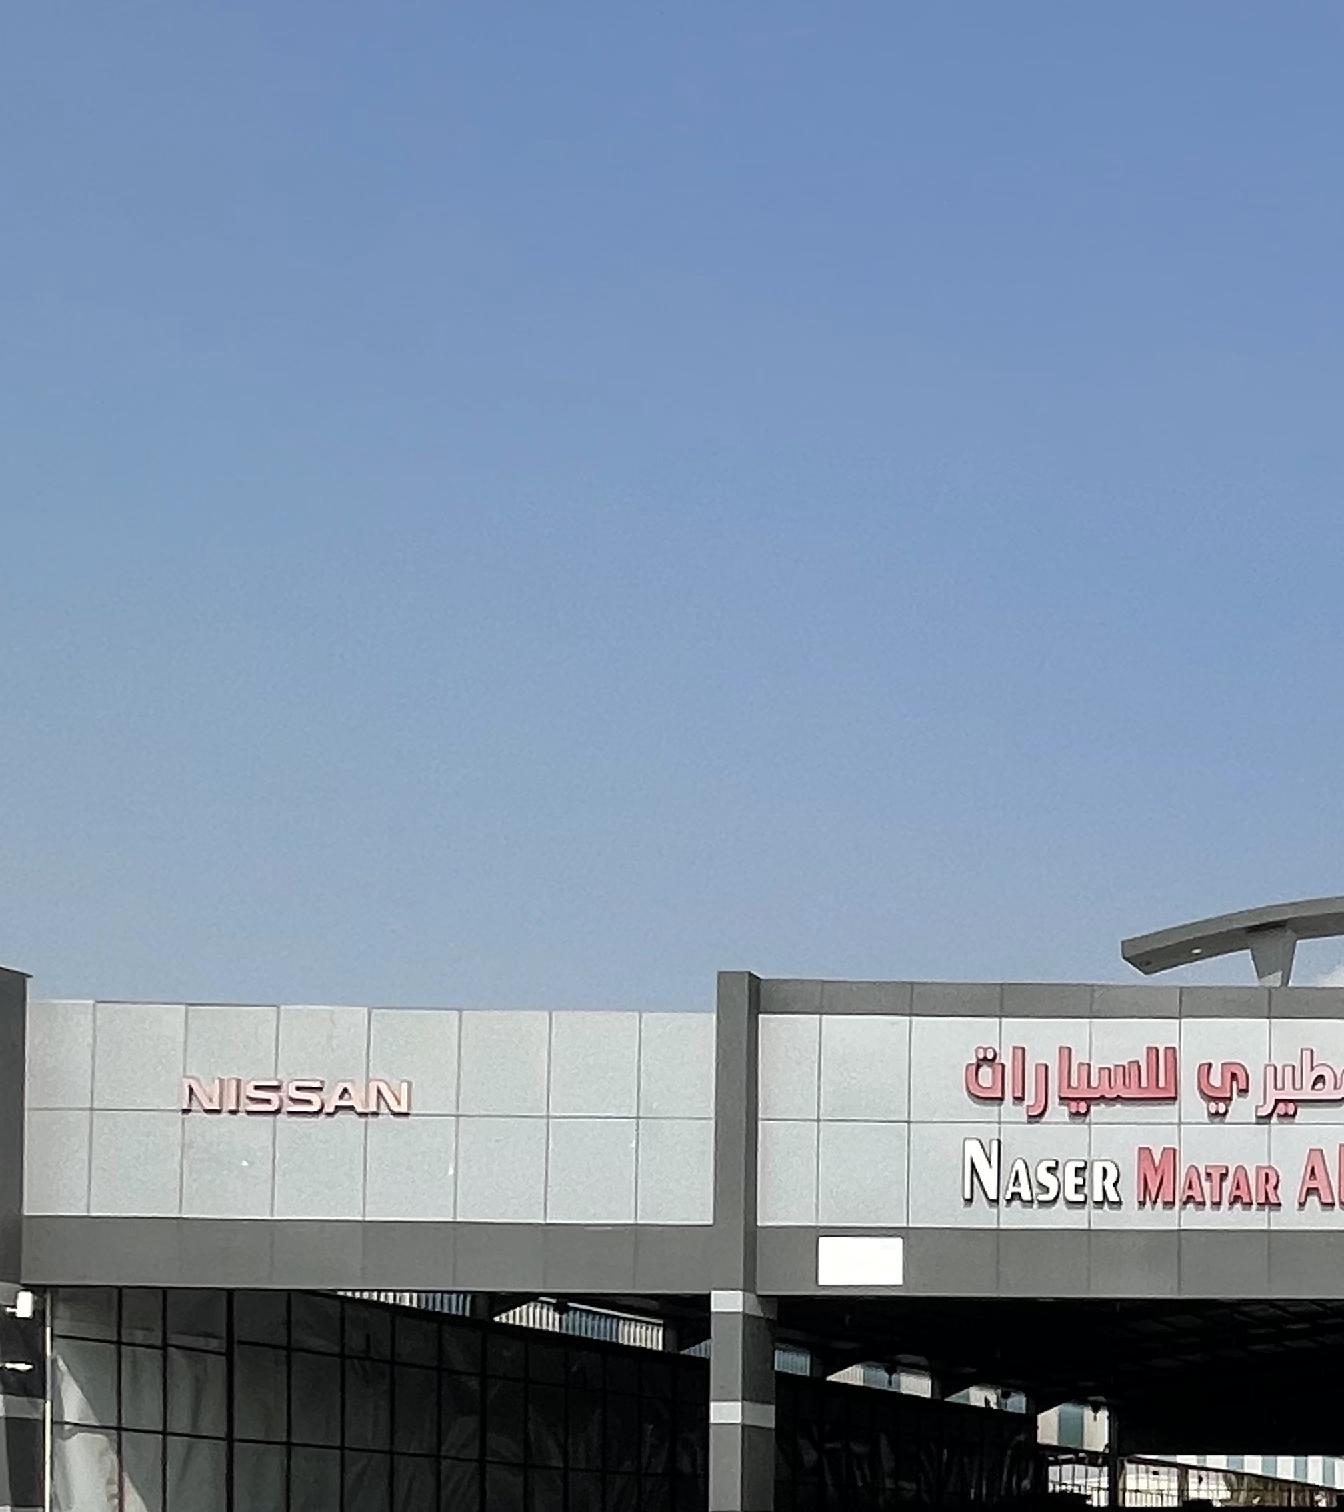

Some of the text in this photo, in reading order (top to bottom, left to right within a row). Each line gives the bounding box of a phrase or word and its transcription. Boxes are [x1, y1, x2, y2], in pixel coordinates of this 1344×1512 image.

[181, 1077, 412, 1116] NISSAN
[964, 1046, 1180, 1117] للسيارات
[961, 1137, 1121, 1207] NASER
[1137, 1146, 1281, 1207] MATAR
